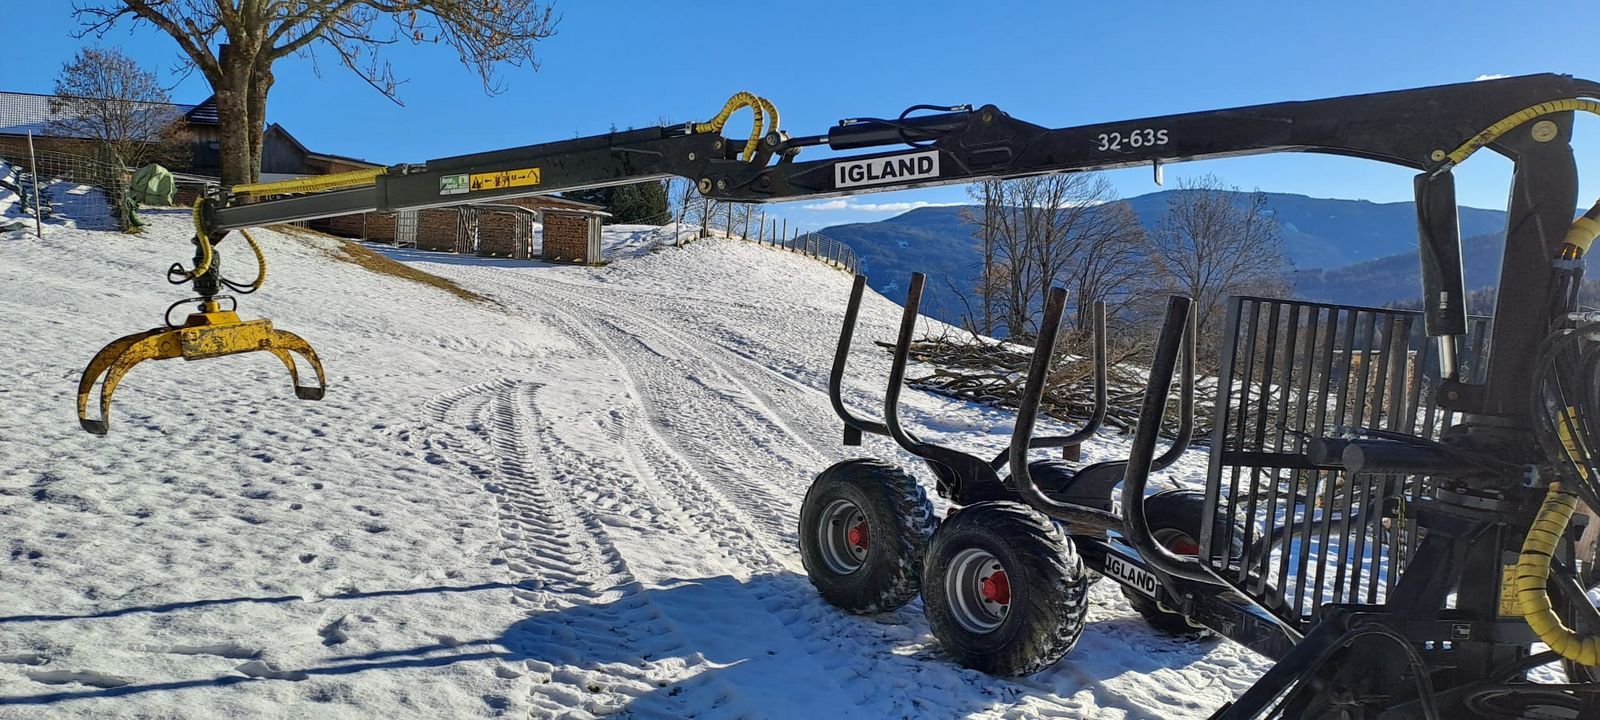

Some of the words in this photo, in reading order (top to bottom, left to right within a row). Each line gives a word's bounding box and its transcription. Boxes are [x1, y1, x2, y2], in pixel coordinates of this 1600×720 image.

[1097, 128, 1169, 151] 32-63S
[840, 155, 934, 184] IGLAND
[1106, 556, 1155, 592] IGLAND
